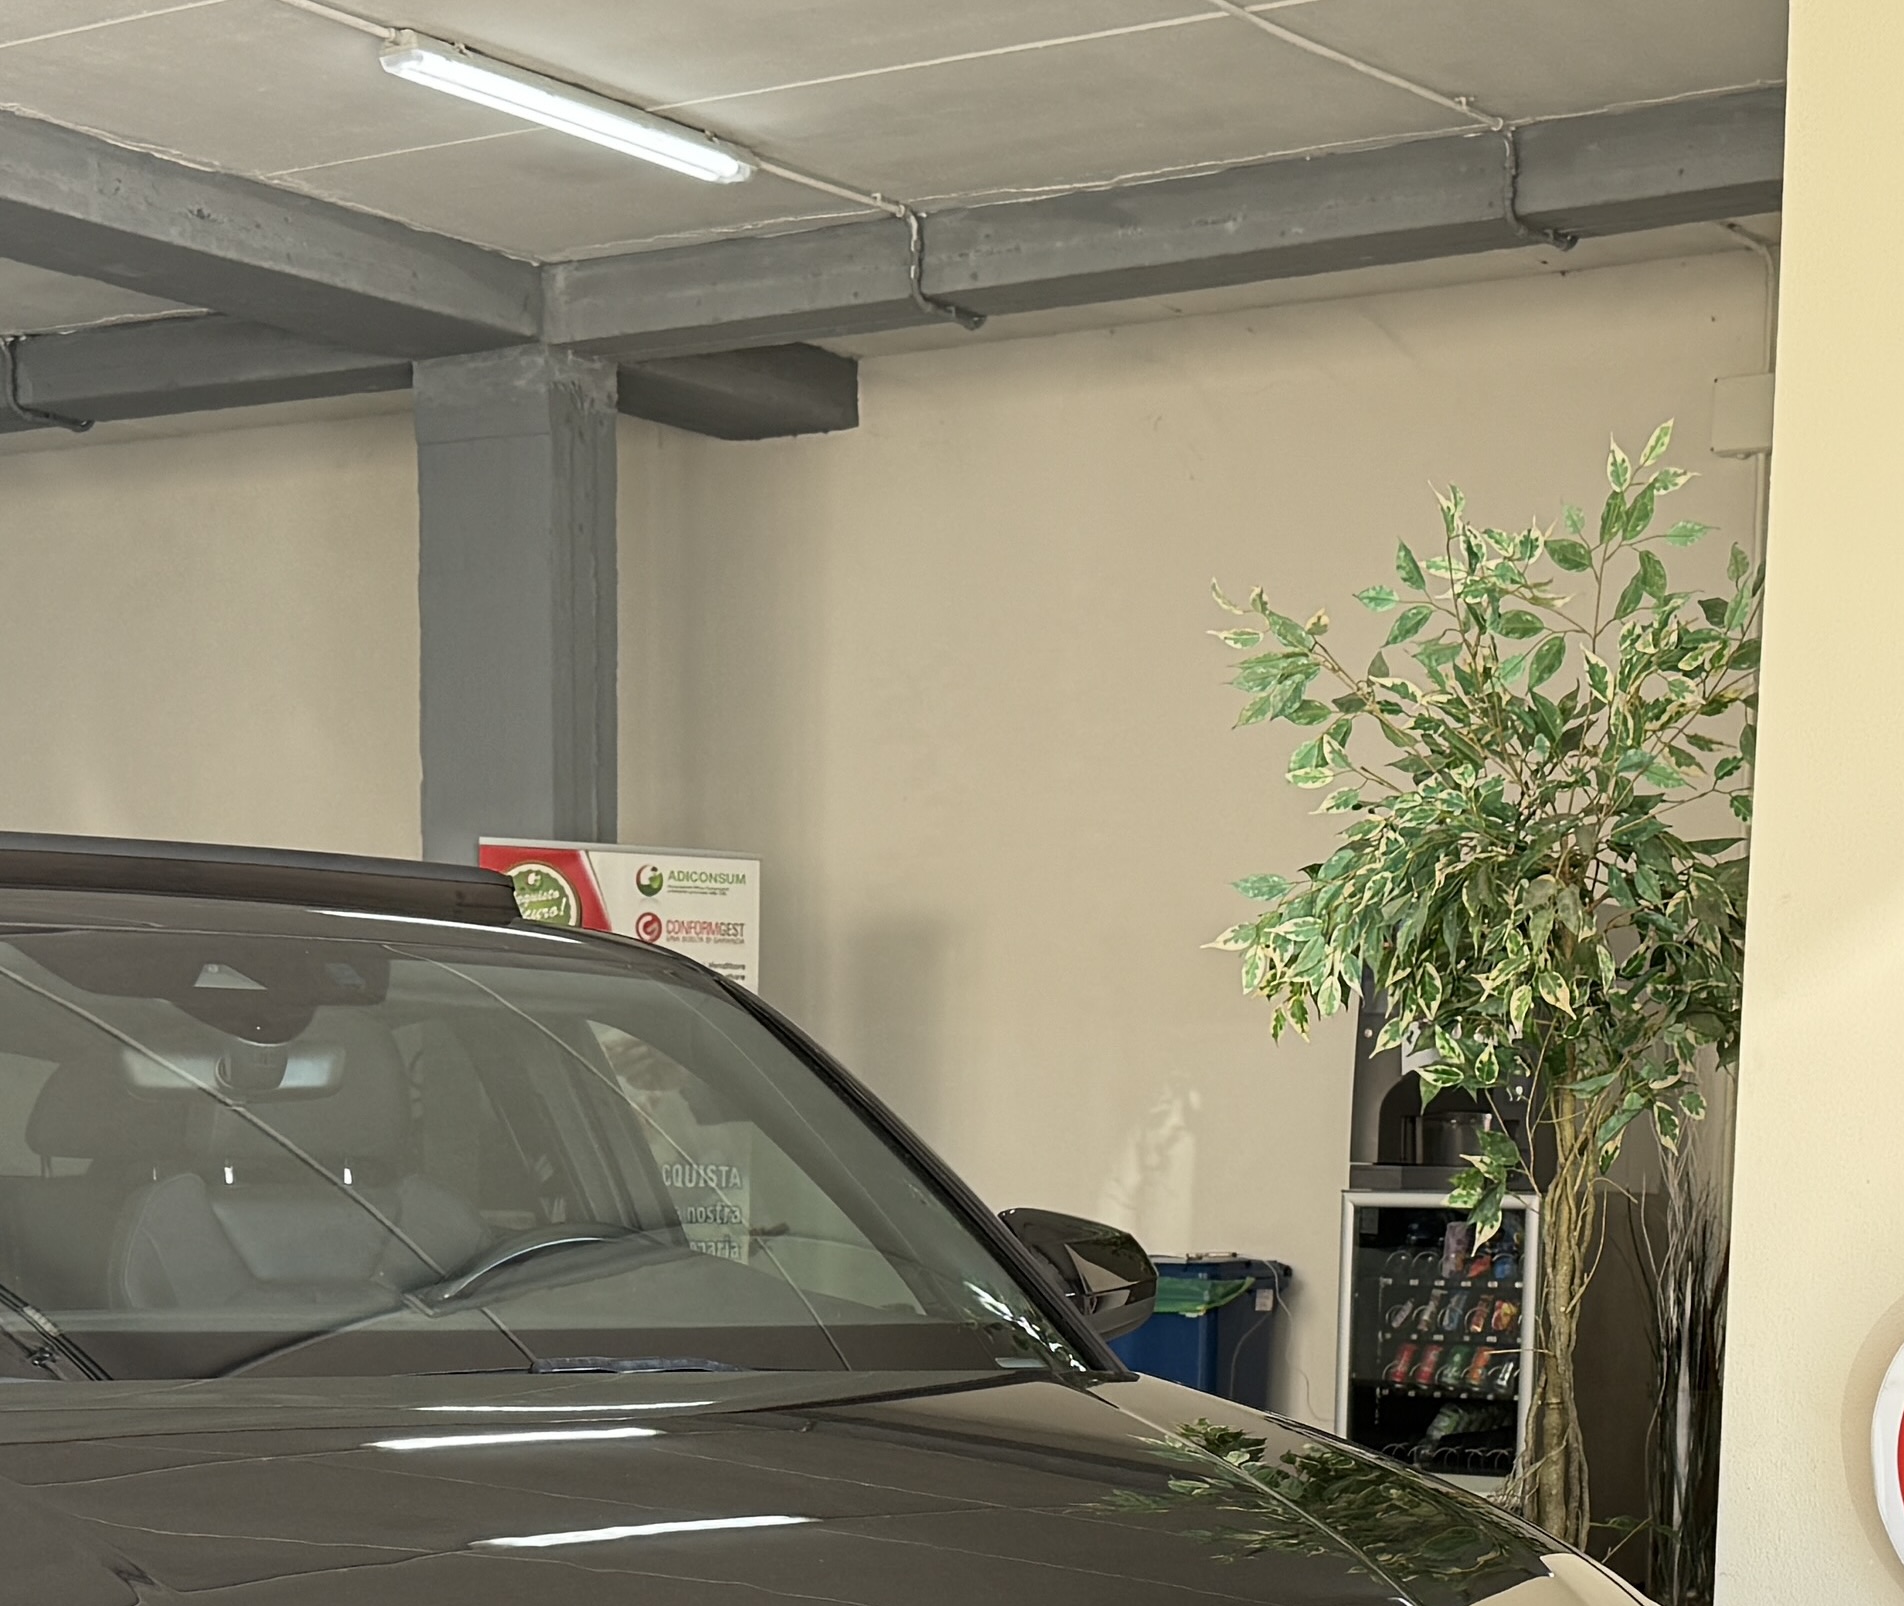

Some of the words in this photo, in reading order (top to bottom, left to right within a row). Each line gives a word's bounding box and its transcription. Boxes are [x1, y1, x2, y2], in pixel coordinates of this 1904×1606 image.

[667, 870, 746, 885] ADICONSUM
[662, 1164, 743, 1188] CQUISTA
[687, 1204, 742, 1224] nostra
